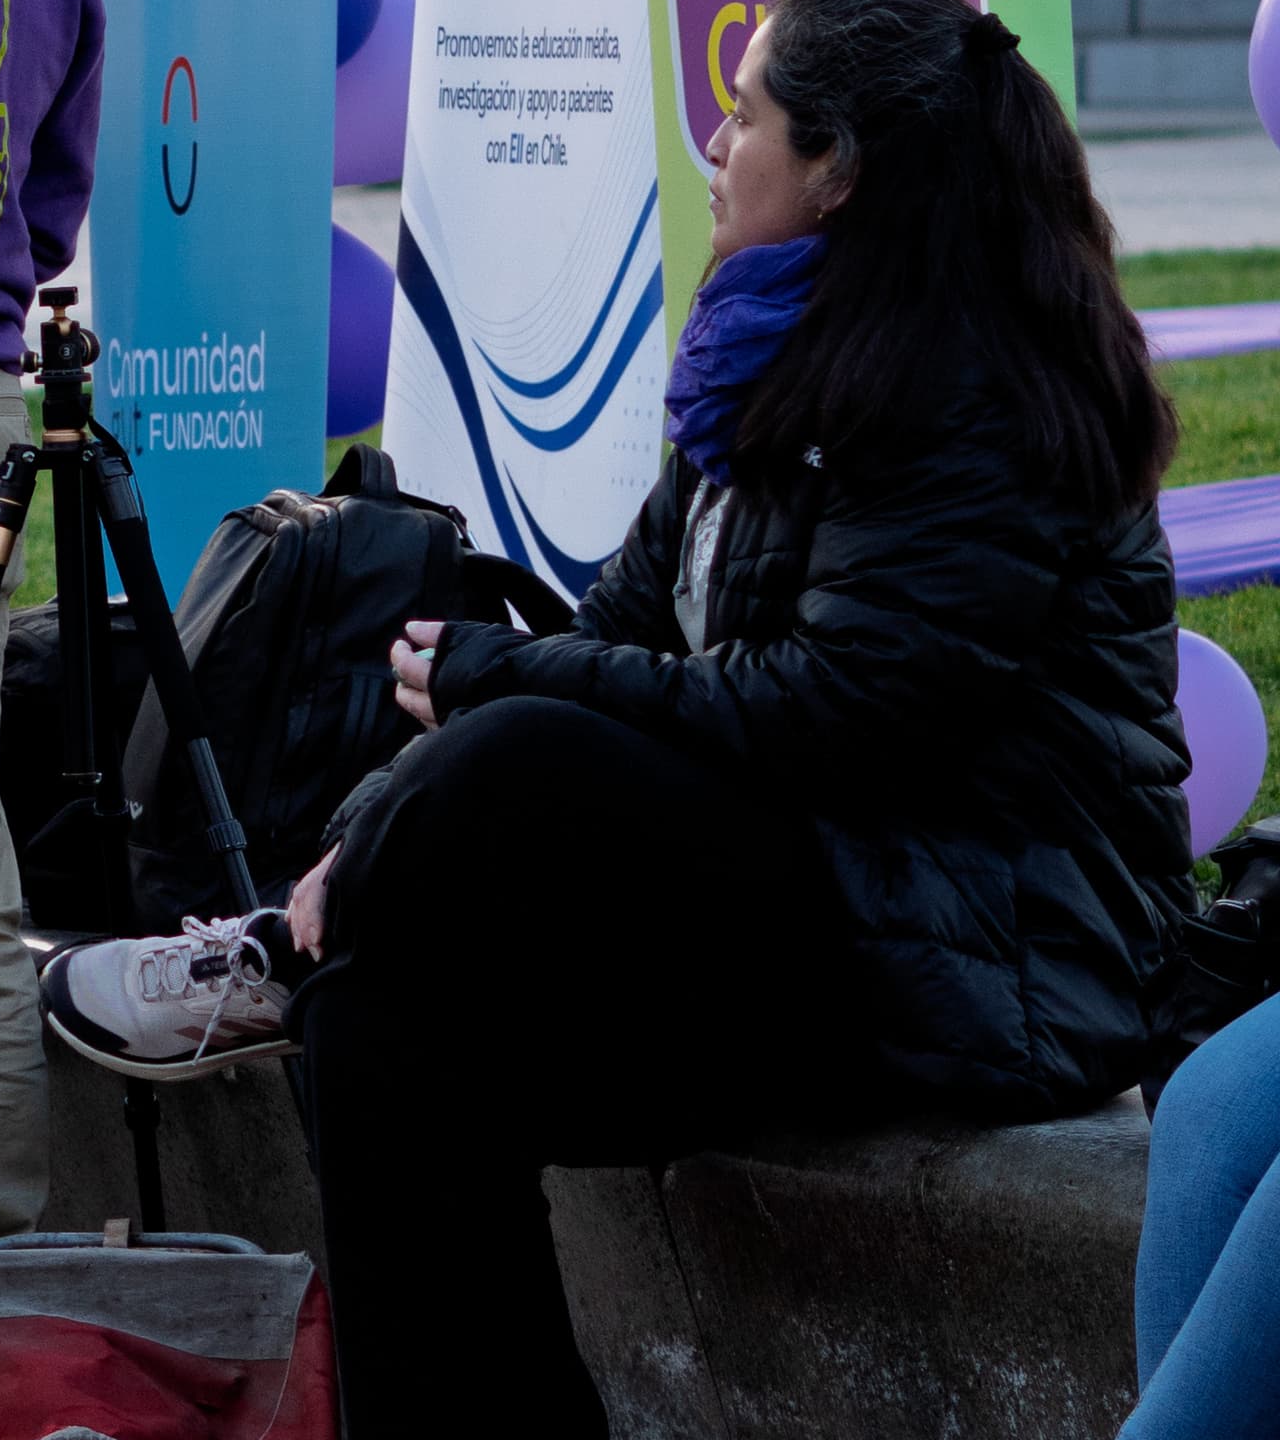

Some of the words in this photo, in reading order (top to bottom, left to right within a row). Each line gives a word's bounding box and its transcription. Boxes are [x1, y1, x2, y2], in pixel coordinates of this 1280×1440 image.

[436, 26, 518, 58] Promovemos
[520, 26, 529, 58] la
[532, 26, 583, 59] educación
[584, 27, 621, 63] médica,
[438, 79, 516, 119] investigación
[516, 89, 525, 120] y
[527, 88, 558, 120] apoyo
[559, 89, 567, 112] a
[568, 82, 614, 120] pacientes
[486, 139, 507, 164] con
[525, 140, 539, 164] en
[541, 133, 568, 166] Chile.
[149, 399, 263, 451] FUNDACIÓN
